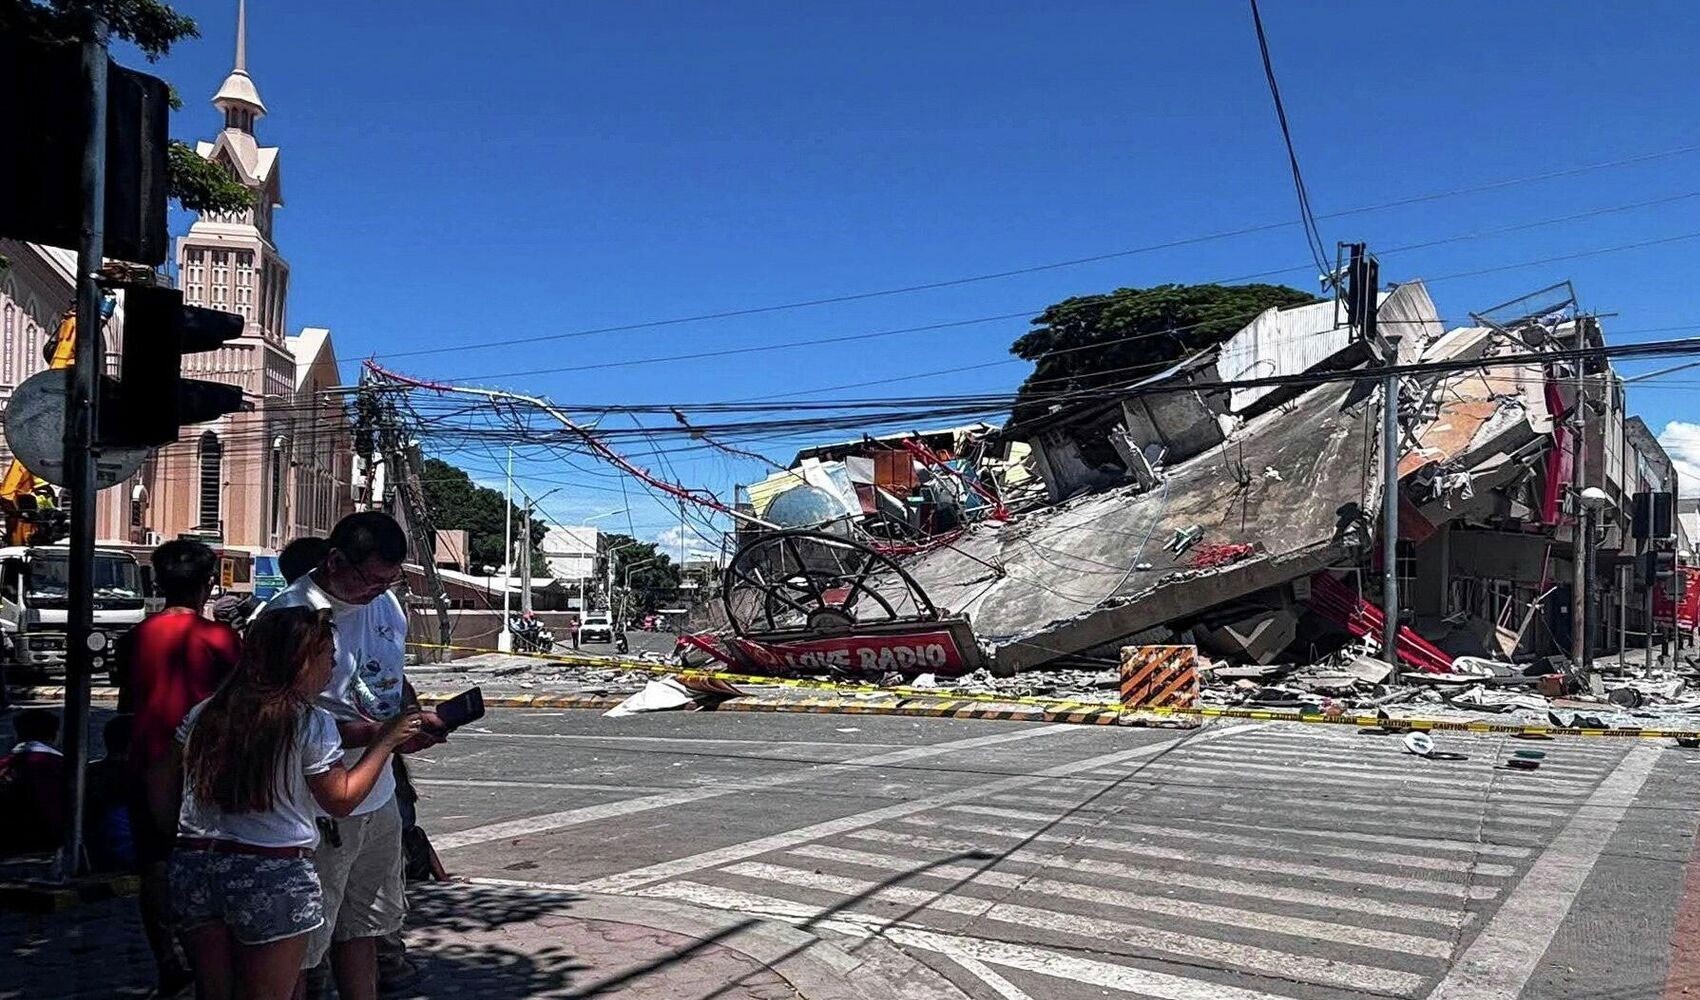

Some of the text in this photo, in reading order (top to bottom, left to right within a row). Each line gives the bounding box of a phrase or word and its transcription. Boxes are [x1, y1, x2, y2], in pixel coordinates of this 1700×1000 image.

[856, 643, 946, 670] RADIO
[1377, 718, 1413, 728] CAUTION
[1432, 722, 1469, 732] CAUTION
[1488, 725, 1526, 734] CAUTION
[1602, 729, 1640, 737] CAUTION
[1661, 730, 1699, 738] CAUTION
